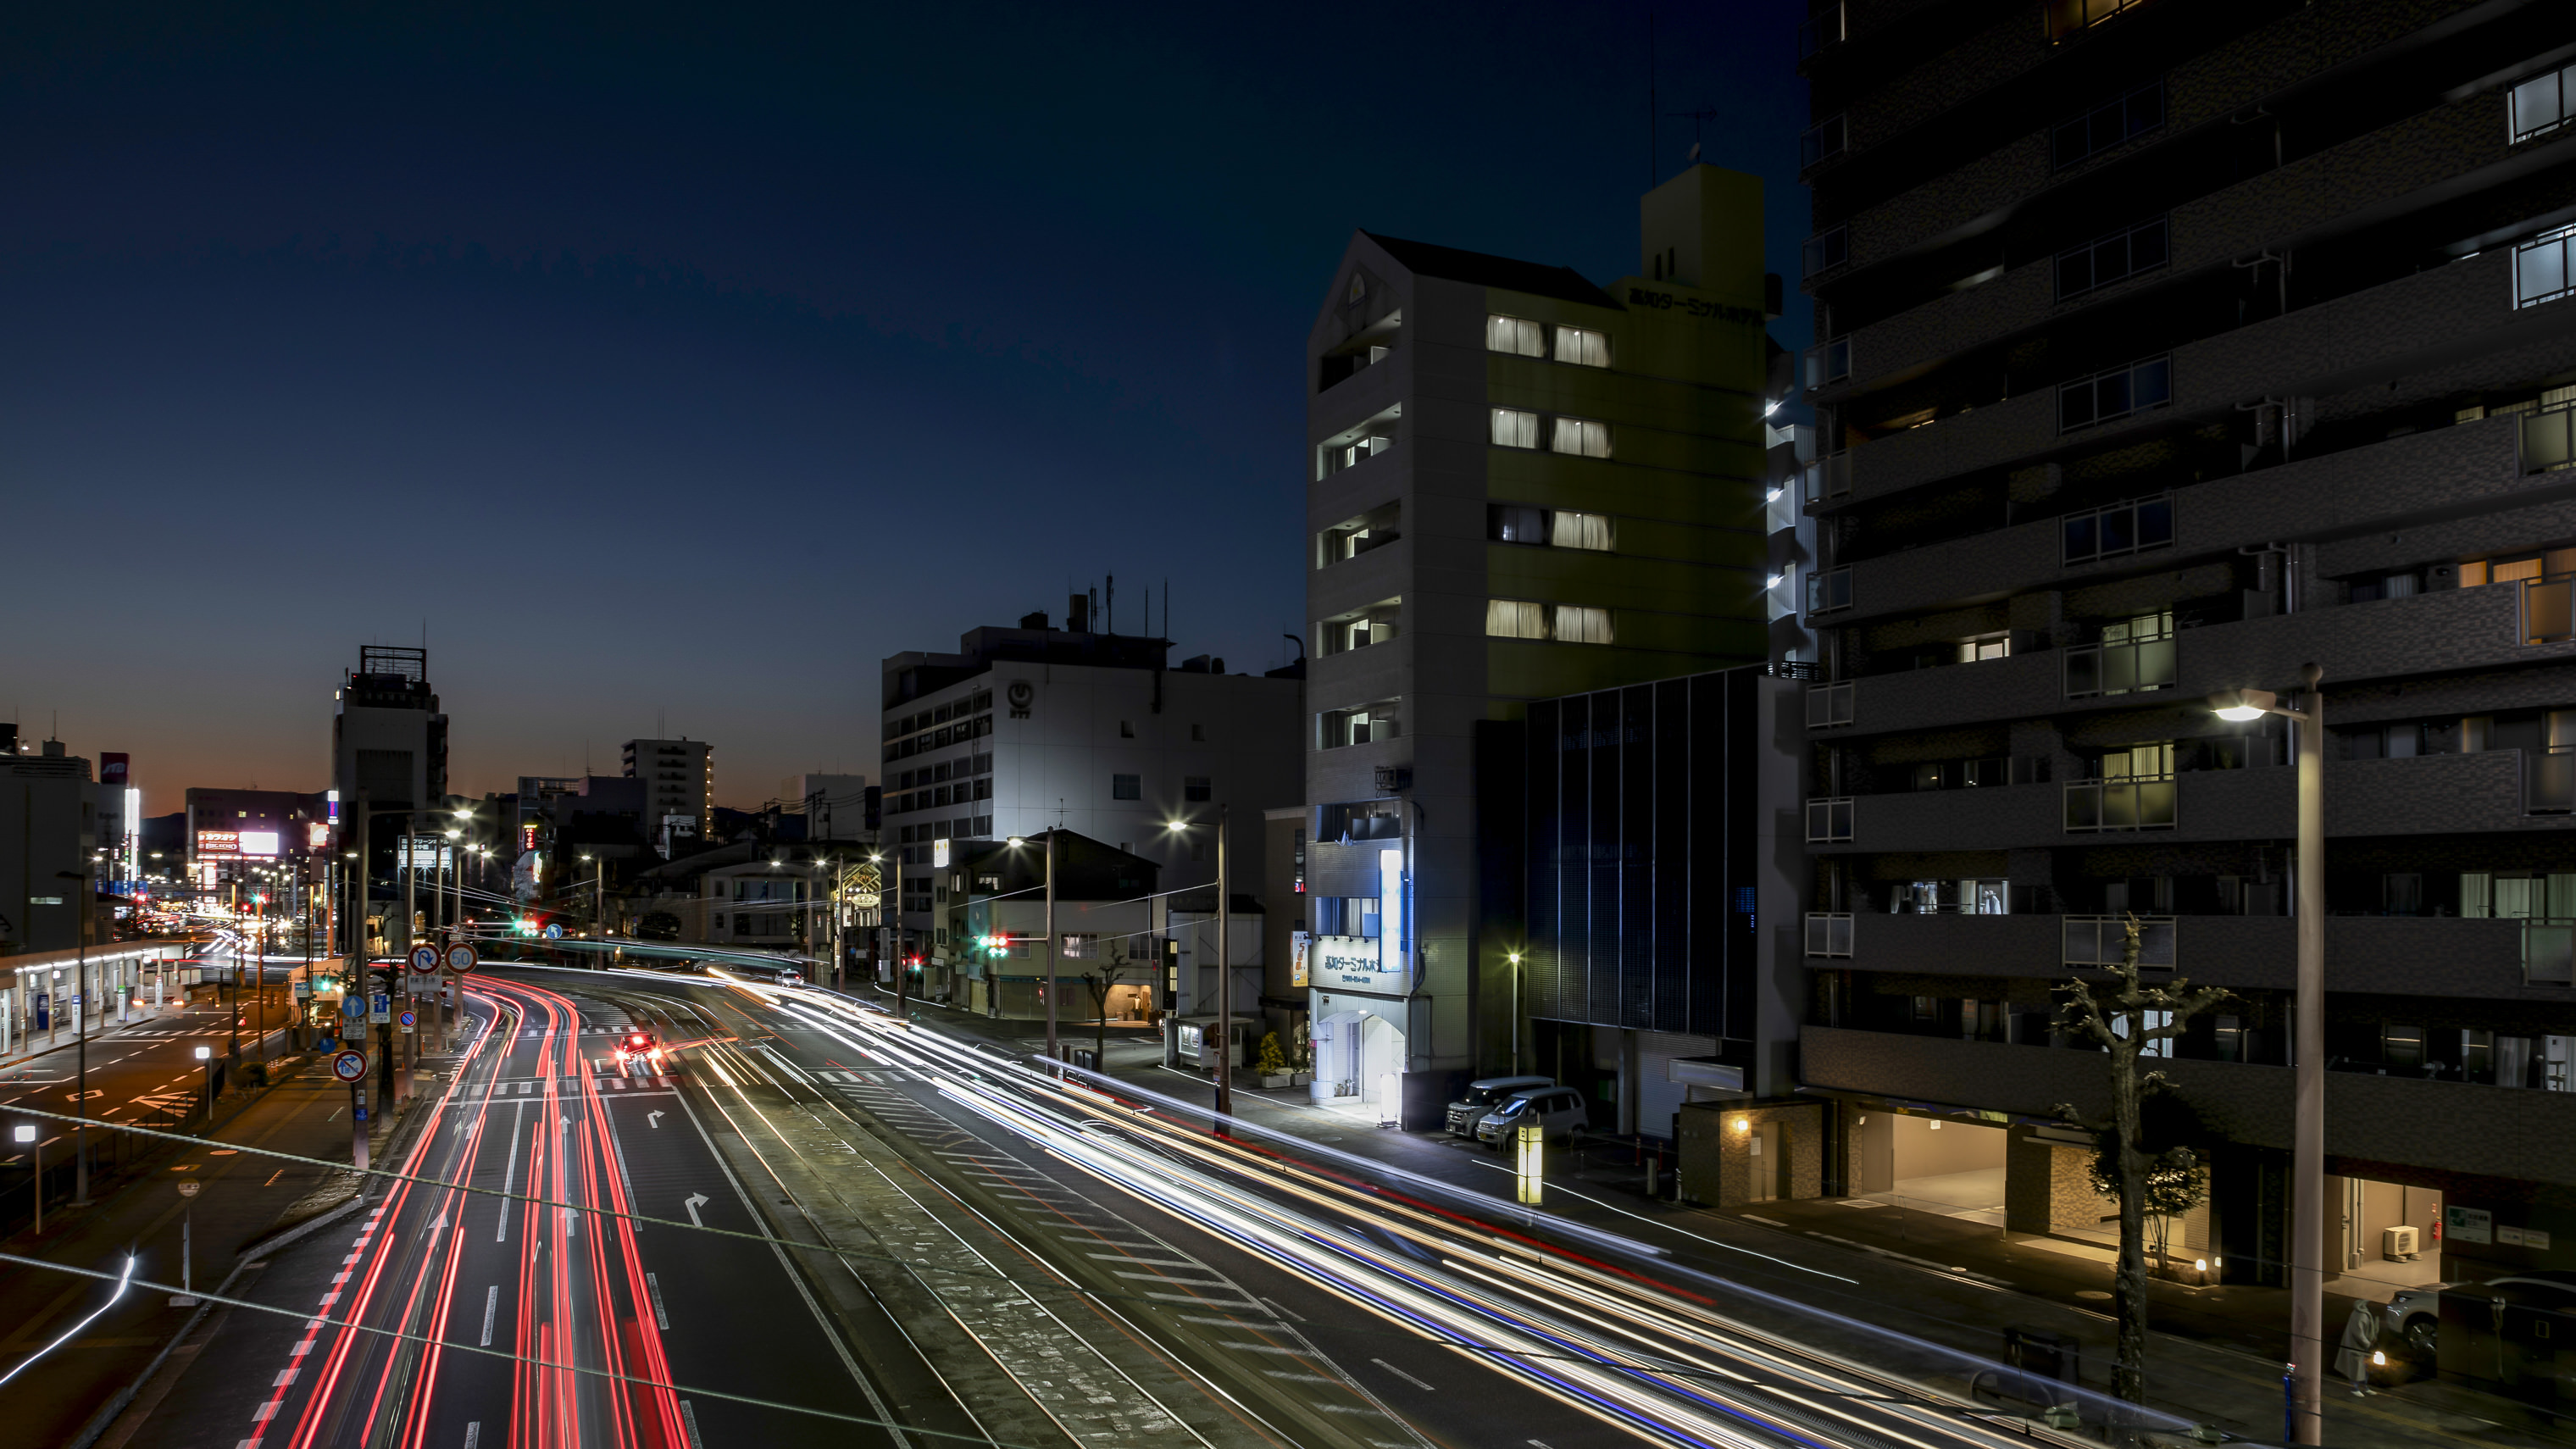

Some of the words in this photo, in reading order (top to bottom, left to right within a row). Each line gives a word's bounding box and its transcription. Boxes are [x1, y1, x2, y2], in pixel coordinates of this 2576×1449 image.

[102, 763, 125, 774] JTB
[452, 952, 470, 965] 50
[1324, 955, 1380, 973] 高知ターミナルホ
